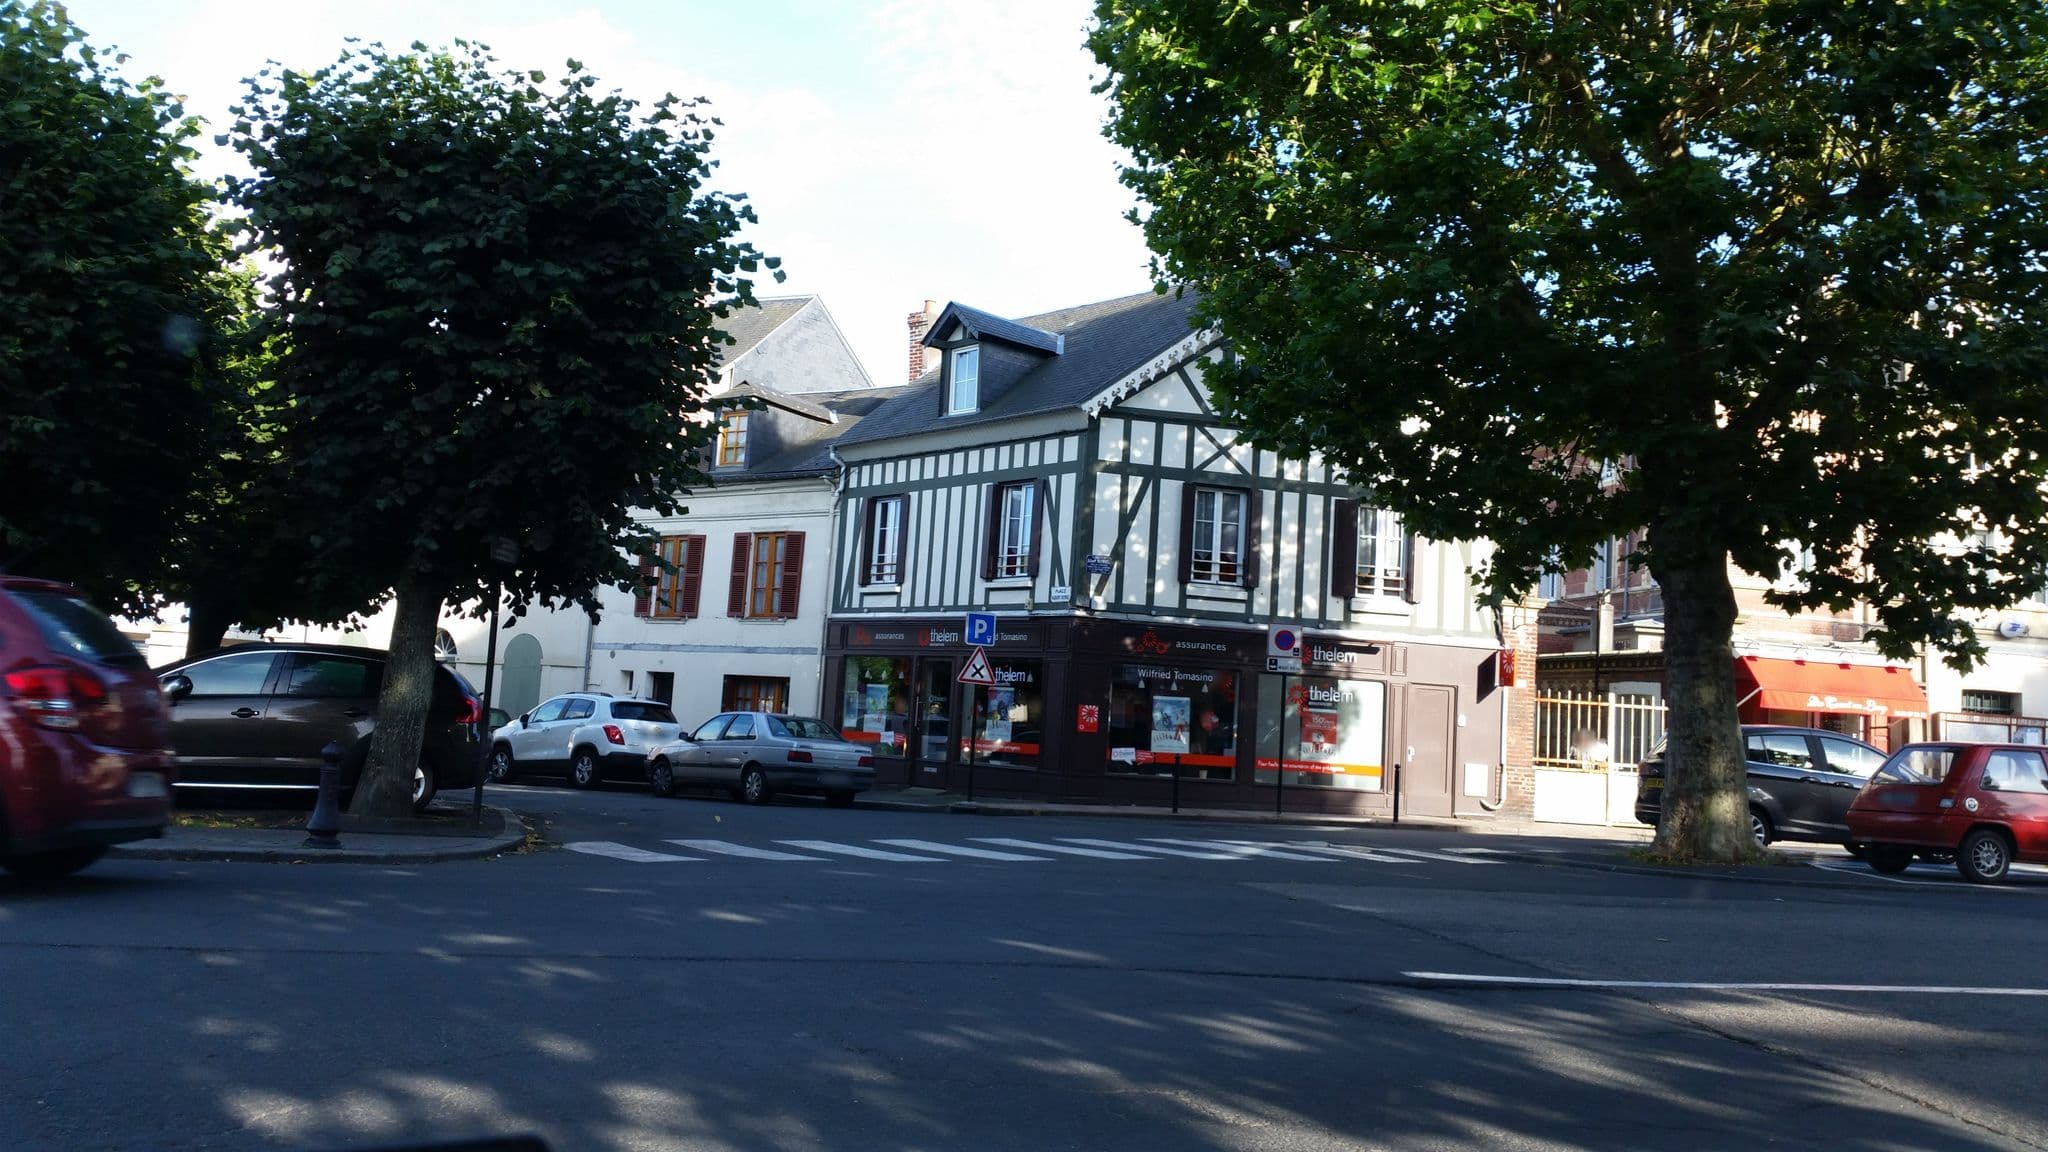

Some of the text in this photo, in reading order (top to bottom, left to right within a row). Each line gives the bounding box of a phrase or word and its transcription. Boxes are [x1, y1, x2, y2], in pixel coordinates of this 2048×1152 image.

[974, 619, 988, 639] P
[1000, 632, 1028, 641] Tomasino
[1175, 640, 1227, 652] assurances
[1137, 668, 1214, 682] Wilfried Tomasino
